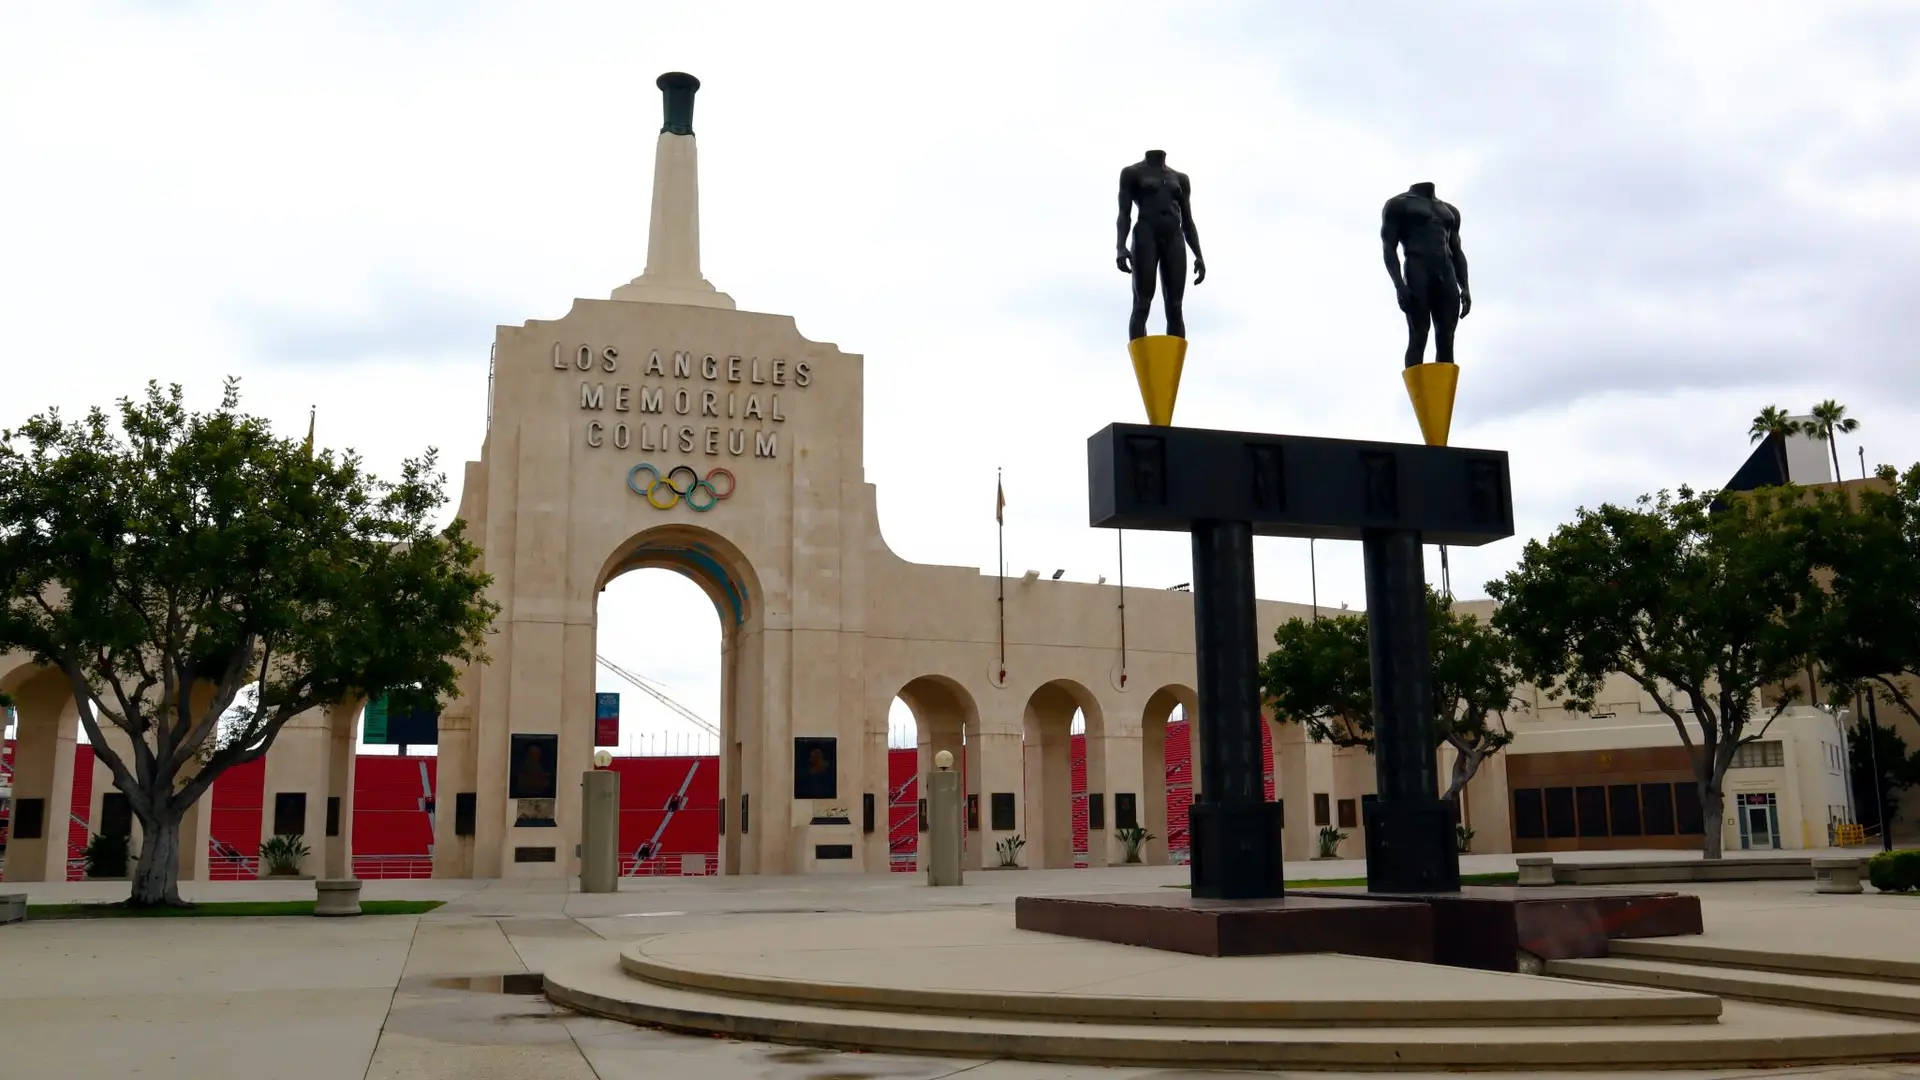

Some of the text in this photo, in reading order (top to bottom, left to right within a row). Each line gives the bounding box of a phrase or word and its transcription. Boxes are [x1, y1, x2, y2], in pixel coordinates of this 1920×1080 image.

[553, 341, 811, 387] LOS ANGELES
[580, 381, 785, 422] MEMORIAL
[587, 420, 777, 459] COLISEUM
